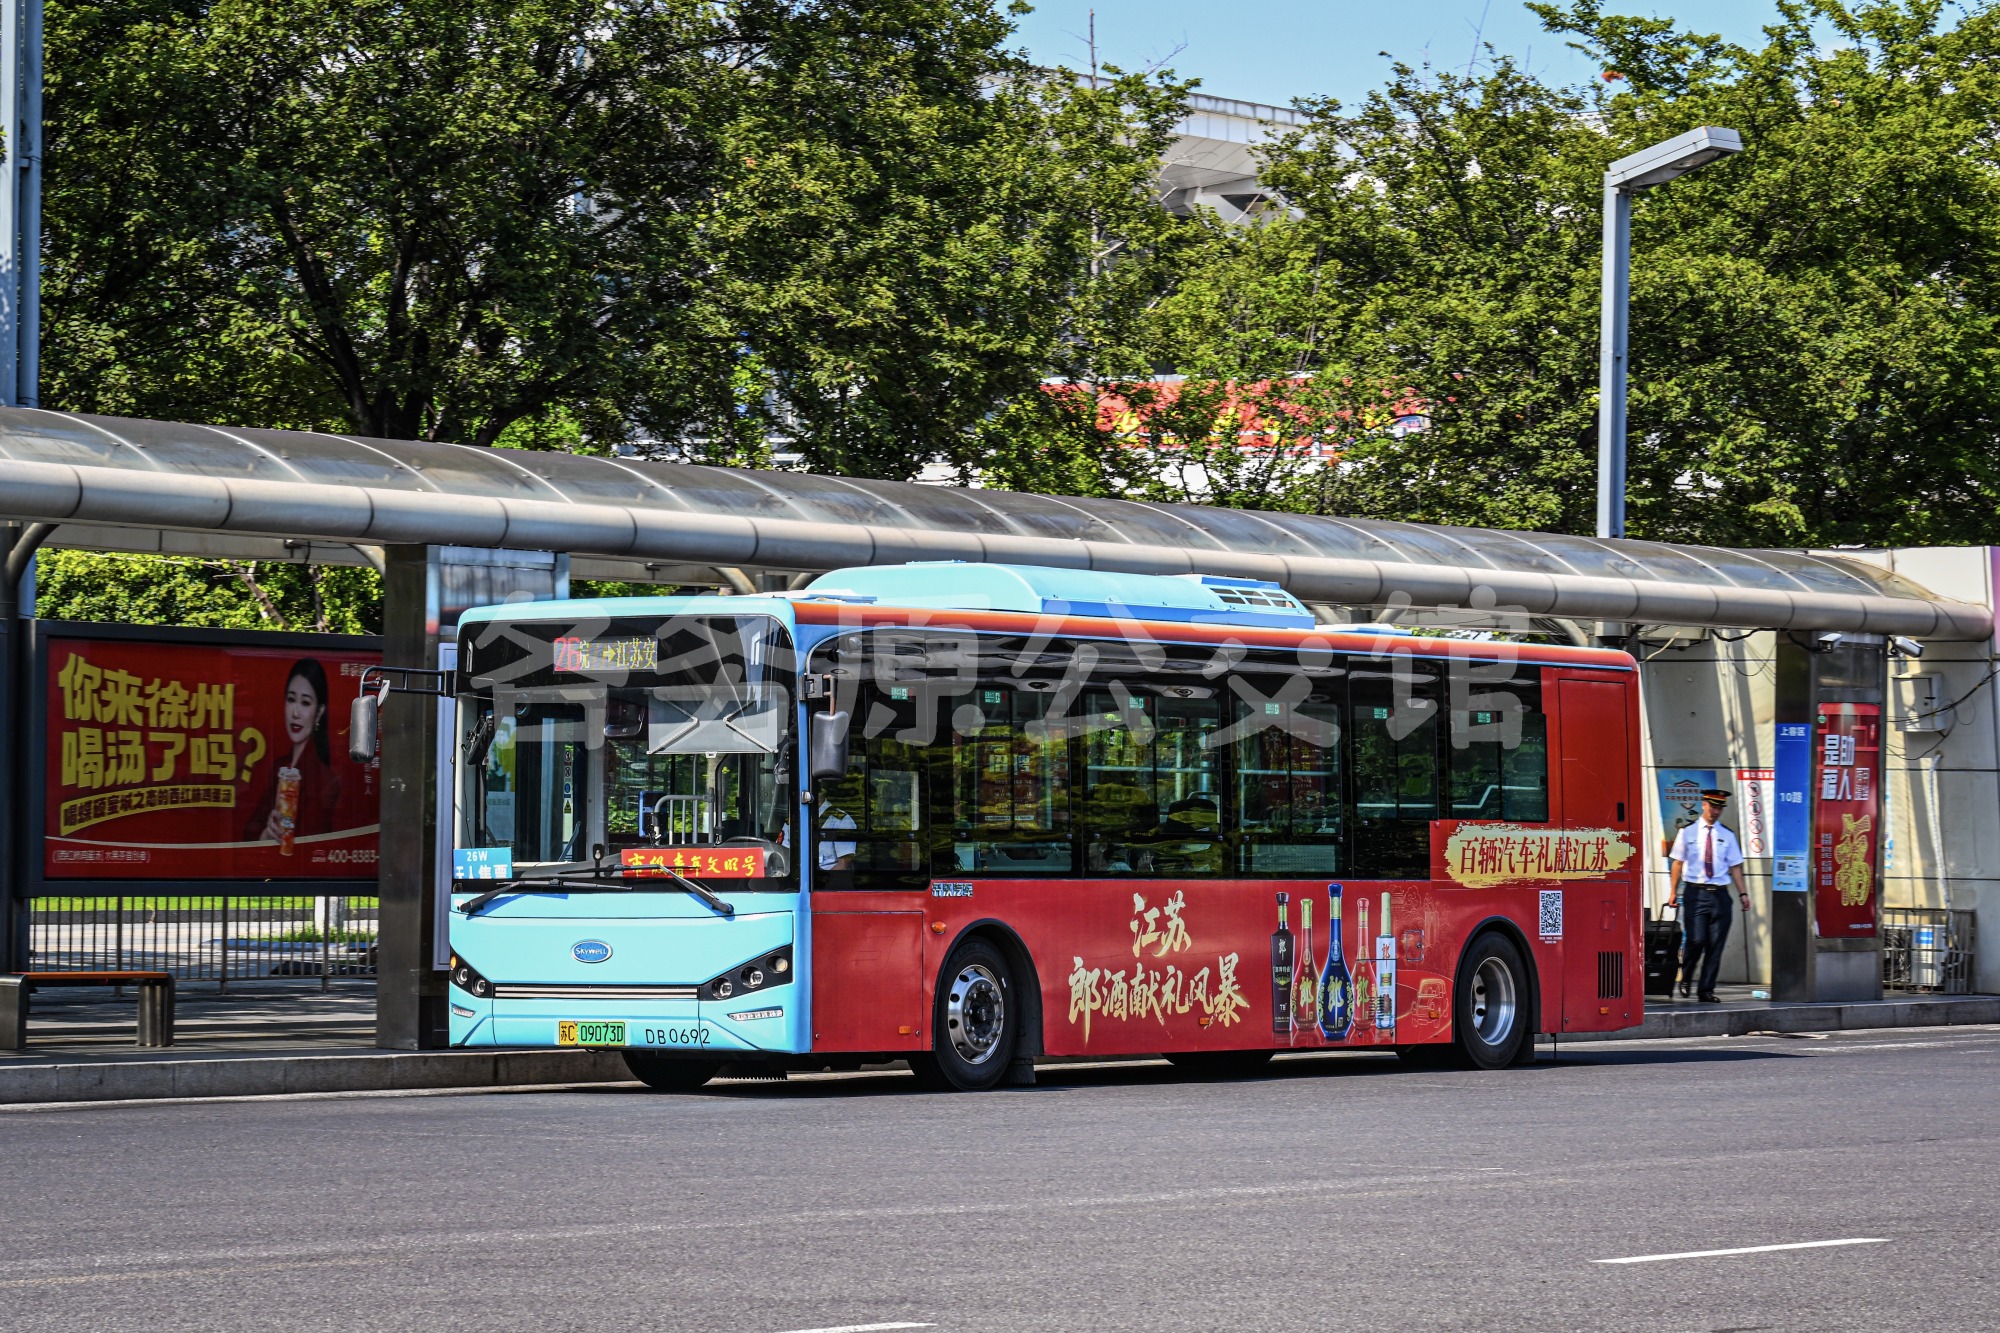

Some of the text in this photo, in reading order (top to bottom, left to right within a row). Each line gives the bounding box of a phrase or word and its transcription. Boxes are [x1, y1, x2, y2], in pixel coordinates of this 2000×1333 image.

[58, 652, 235, 730] 你来徐州
[1780, 792, 1803, 803] 10路
[466, 851, 488, 862] 26W
[1459, 836, 1610, 875] 百辆汽车礼献江苏
[1130, 889, 1192, 958] 江苏
[1068, 952, 1250, 1047] 郎酒献礼风暴
[1327, 975, 1345, 1028] 郎
[646, 1028, 710, 1044] DB0692
